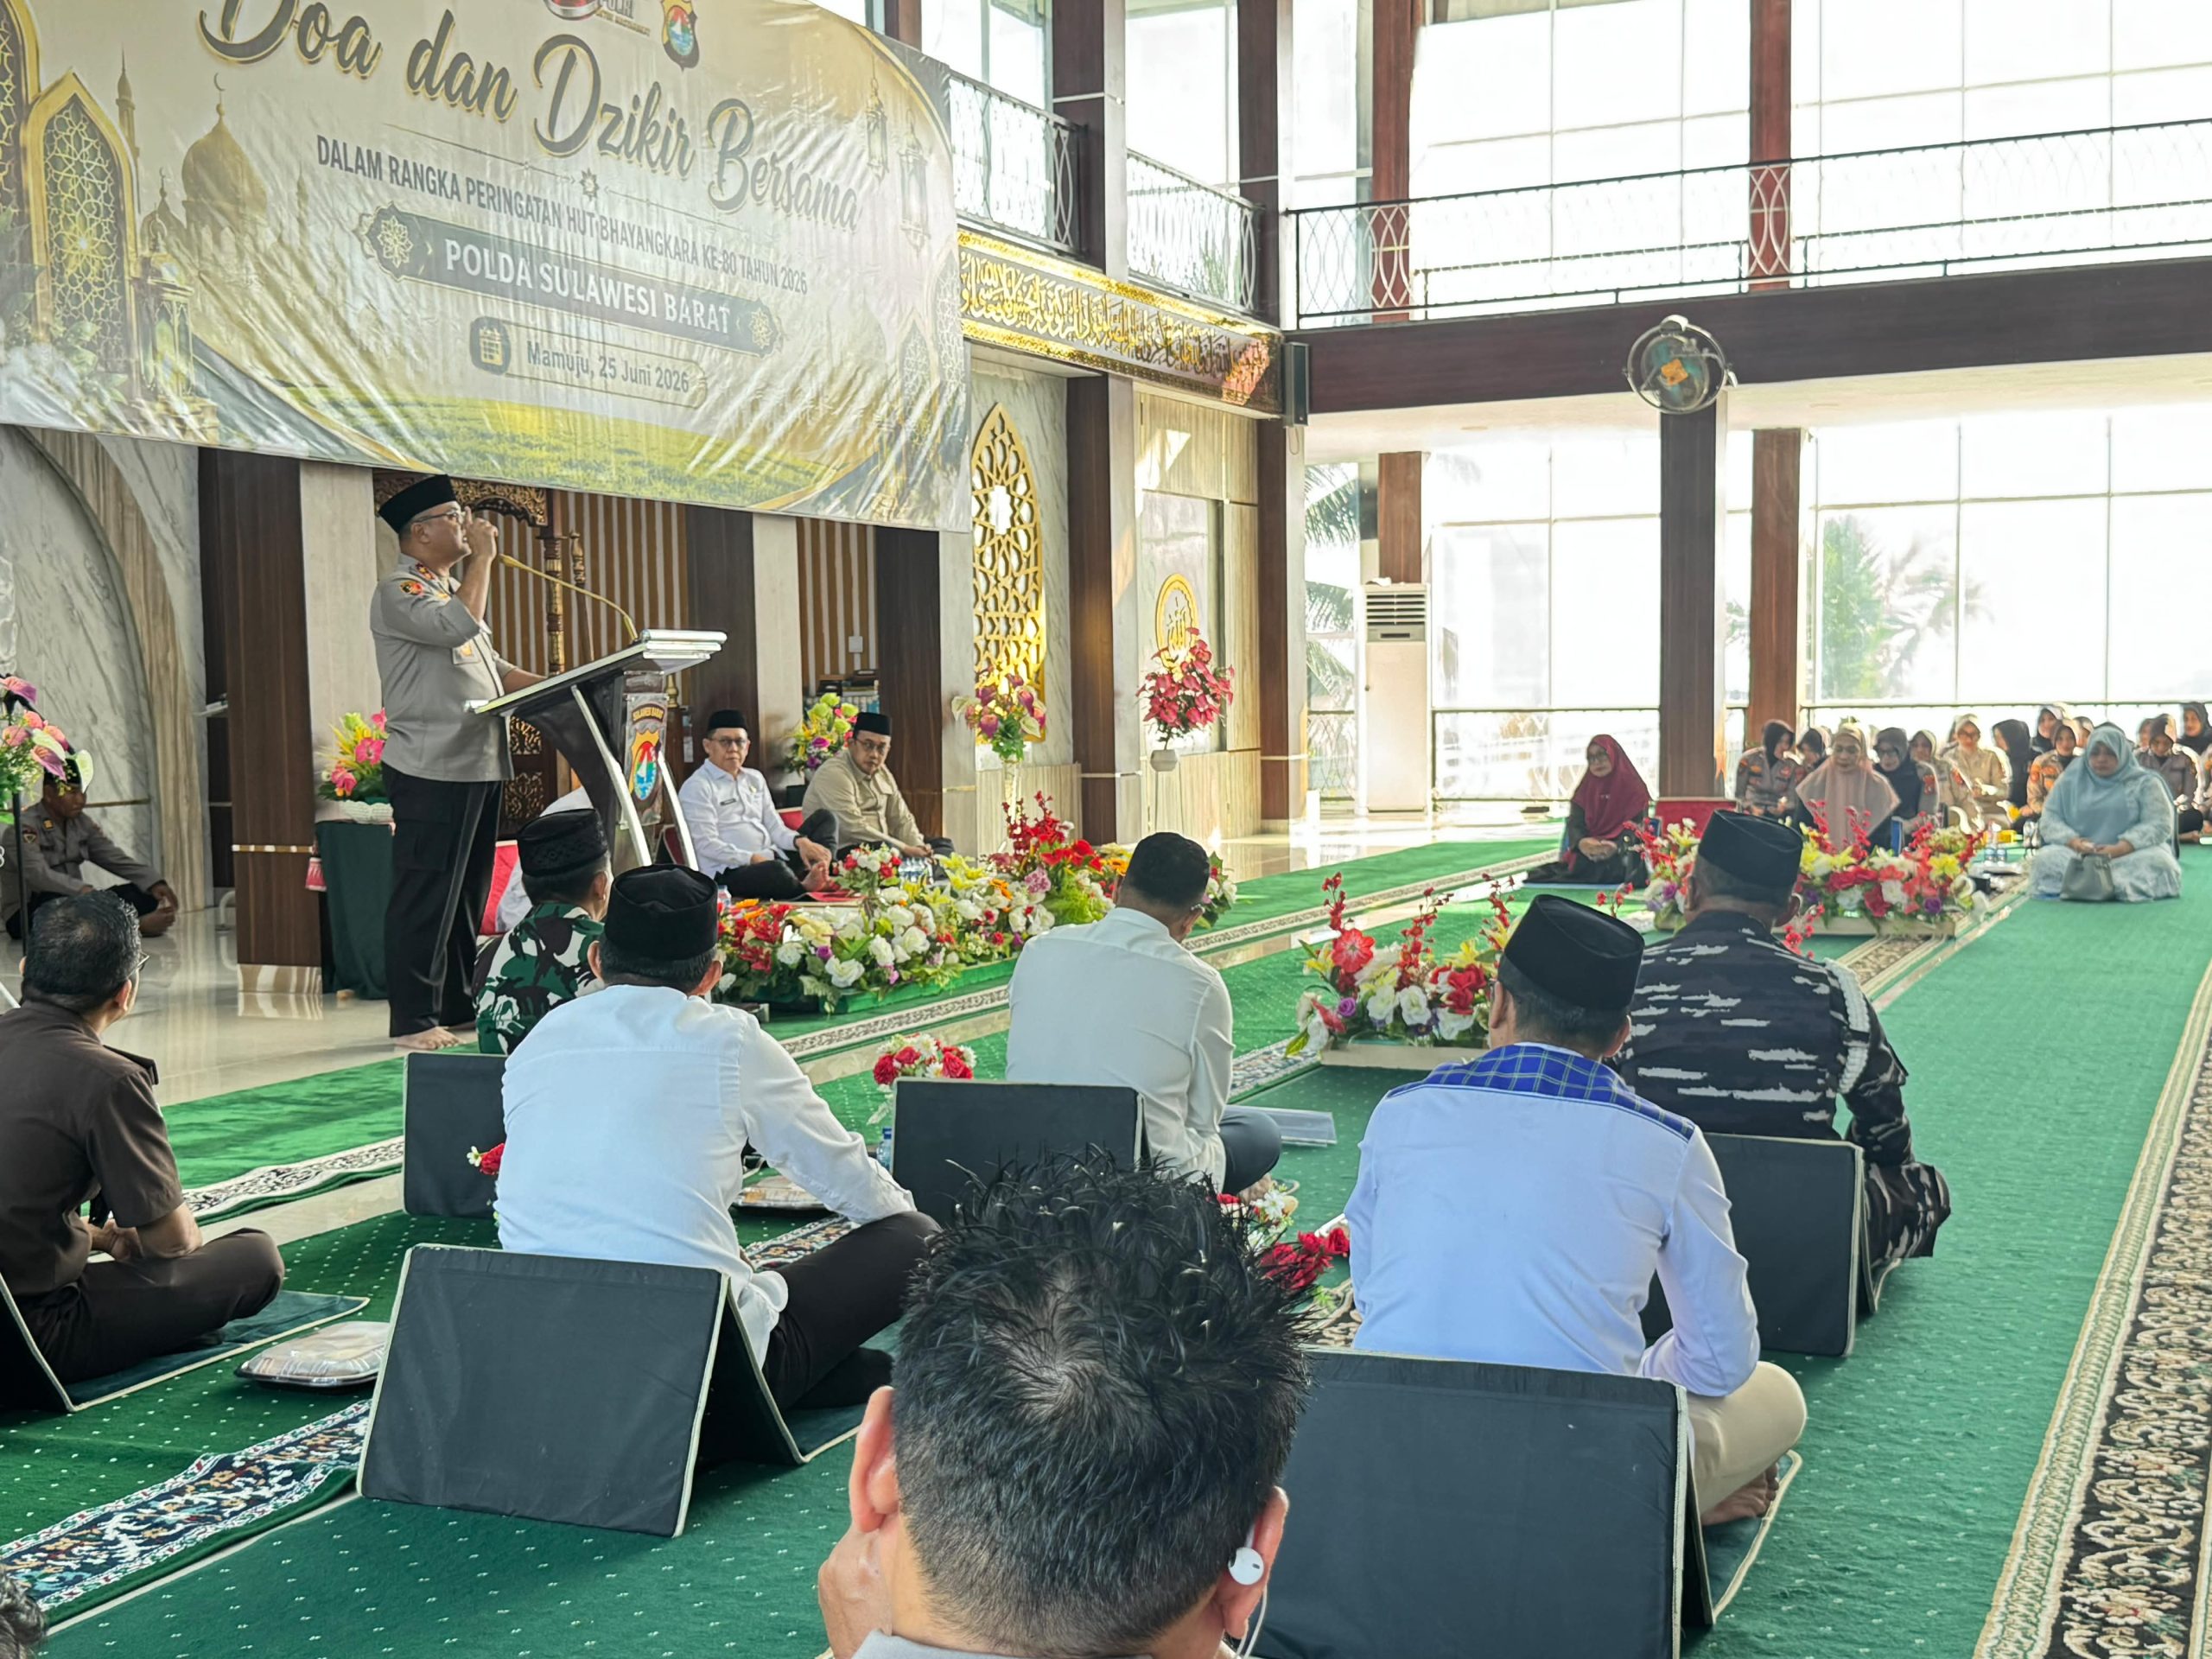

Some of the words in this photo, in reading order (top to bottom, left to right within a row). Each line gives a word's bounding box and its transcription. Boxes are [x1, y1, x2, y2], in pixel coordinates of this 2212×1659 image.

[406, 9, 518, 123] dan
[533, 34, 696, 181] Dzikir
[707, 98, 862, 232] Bersama
[317, 135, 383, 181] DALAM
[388, 155, 461, 202] RANGKA
[466, 175, 563, 229] PERINGATAN
[566, 205, 595, 238] HUT
[600, 214, 699, 266] BHAYANGKARA
[702, 244, 736, 276] KE-80
[739, 254, 779, 288] TAHUN
[780, 266, 809, 296] 2026
[445, 238, 533, 289] POLDA
[538, 262, 658, 318] SULAWESI
[664, 291, 731, 334] BARAT
[527, 340, 594, 379] Mamuju,
[598, 355, 617, 379] 25
[621, 359, 652, 387] Juni
[655, 368, 690, 394] 2026
